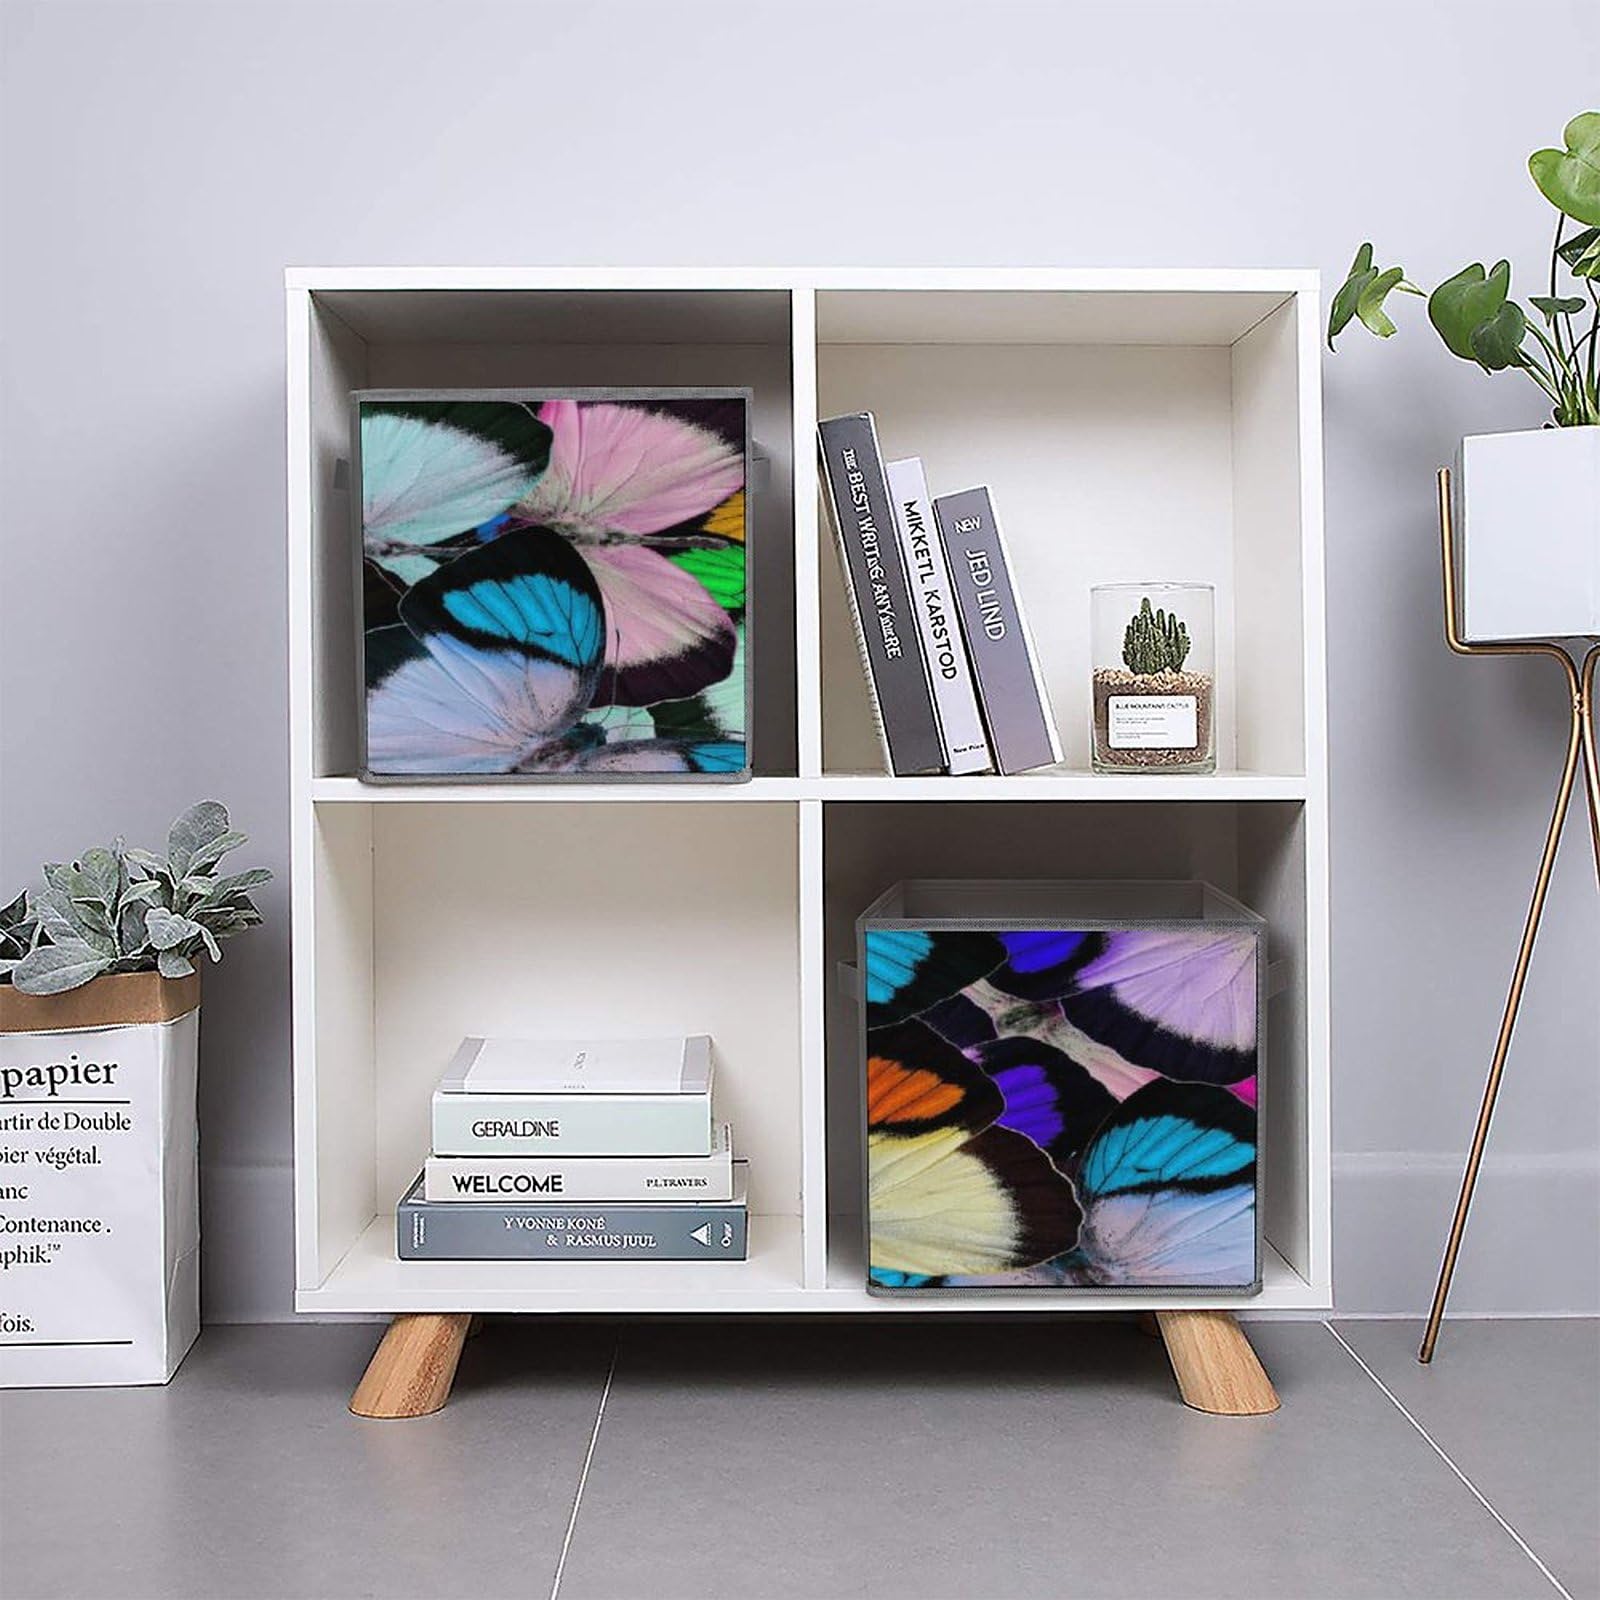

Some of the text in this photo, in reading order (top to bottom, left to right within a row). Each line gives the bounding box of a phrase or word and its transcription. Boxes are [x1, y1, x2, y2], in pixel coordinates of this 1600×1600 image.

[849, 471, 871, 513] BEST
[955, 516, 981, 534] NEW
[903, 500, 957, 680] MIKKETL KARSTOD
[966, 549, 1007, 641] JED LIND
[0, 1055, 118, 1098] papier
[0, 1111, 131, 1131] rtir de Double
[472, 1120, 559, 1138] GERALDINE
[0, 1145, 102, 1170] ier végétal.
[452, 1174, 564, 1193] WELCOME
[546, 1234, 657, 1248] & RASMUS JUUL
